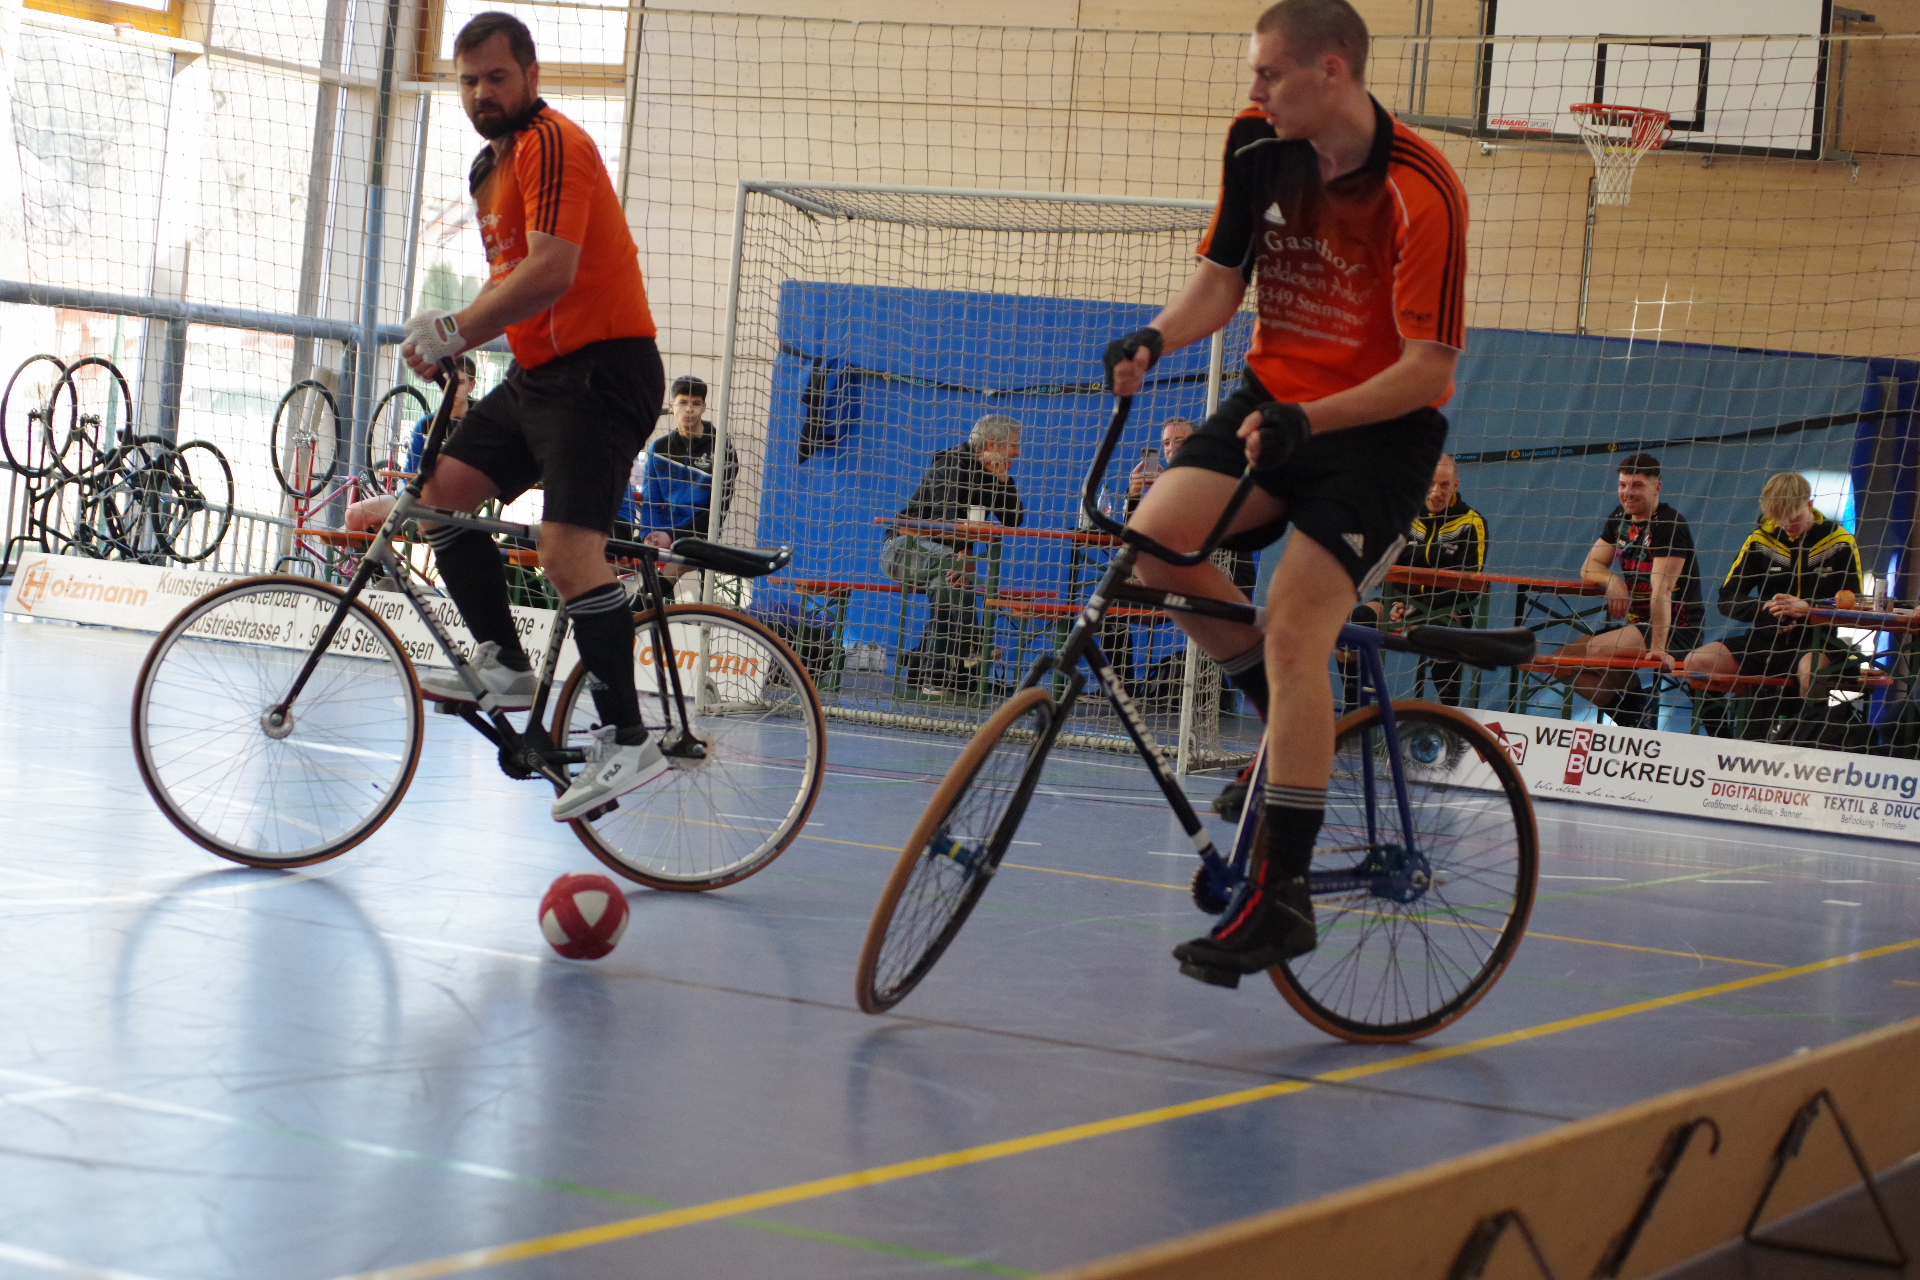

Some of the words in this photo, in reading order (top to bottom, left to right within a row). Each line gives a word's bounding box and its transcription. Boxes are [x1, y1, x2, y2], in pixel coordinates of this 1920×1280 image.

[1490, 118, 1528, 127] ERHARD
[1529, 120, 1550, 128] SPORT
[1263, 230, 1367, 277] Gasthof
[23, 570, 149, 606] Holzmann
[282, 620, 294, 643] 3
[309, 624, 351, 650] 949
[1535, 726, 1662, 759] WERBUNG
[602, 763, 622, 782] FILA
[1566, 753, 1706, 789] BUCKREUS
[1717, 754, 1919, 798] www.werbung
[1702, 798, 1739, 812] Großformat
[1881, 818, 1907, 831] Transfer
[1711, 782, 1811, 807] DIGITALDRUCK
[1823, 795, 1865, 814] TEXTIL
[1869, 801, 1879, 815] &
